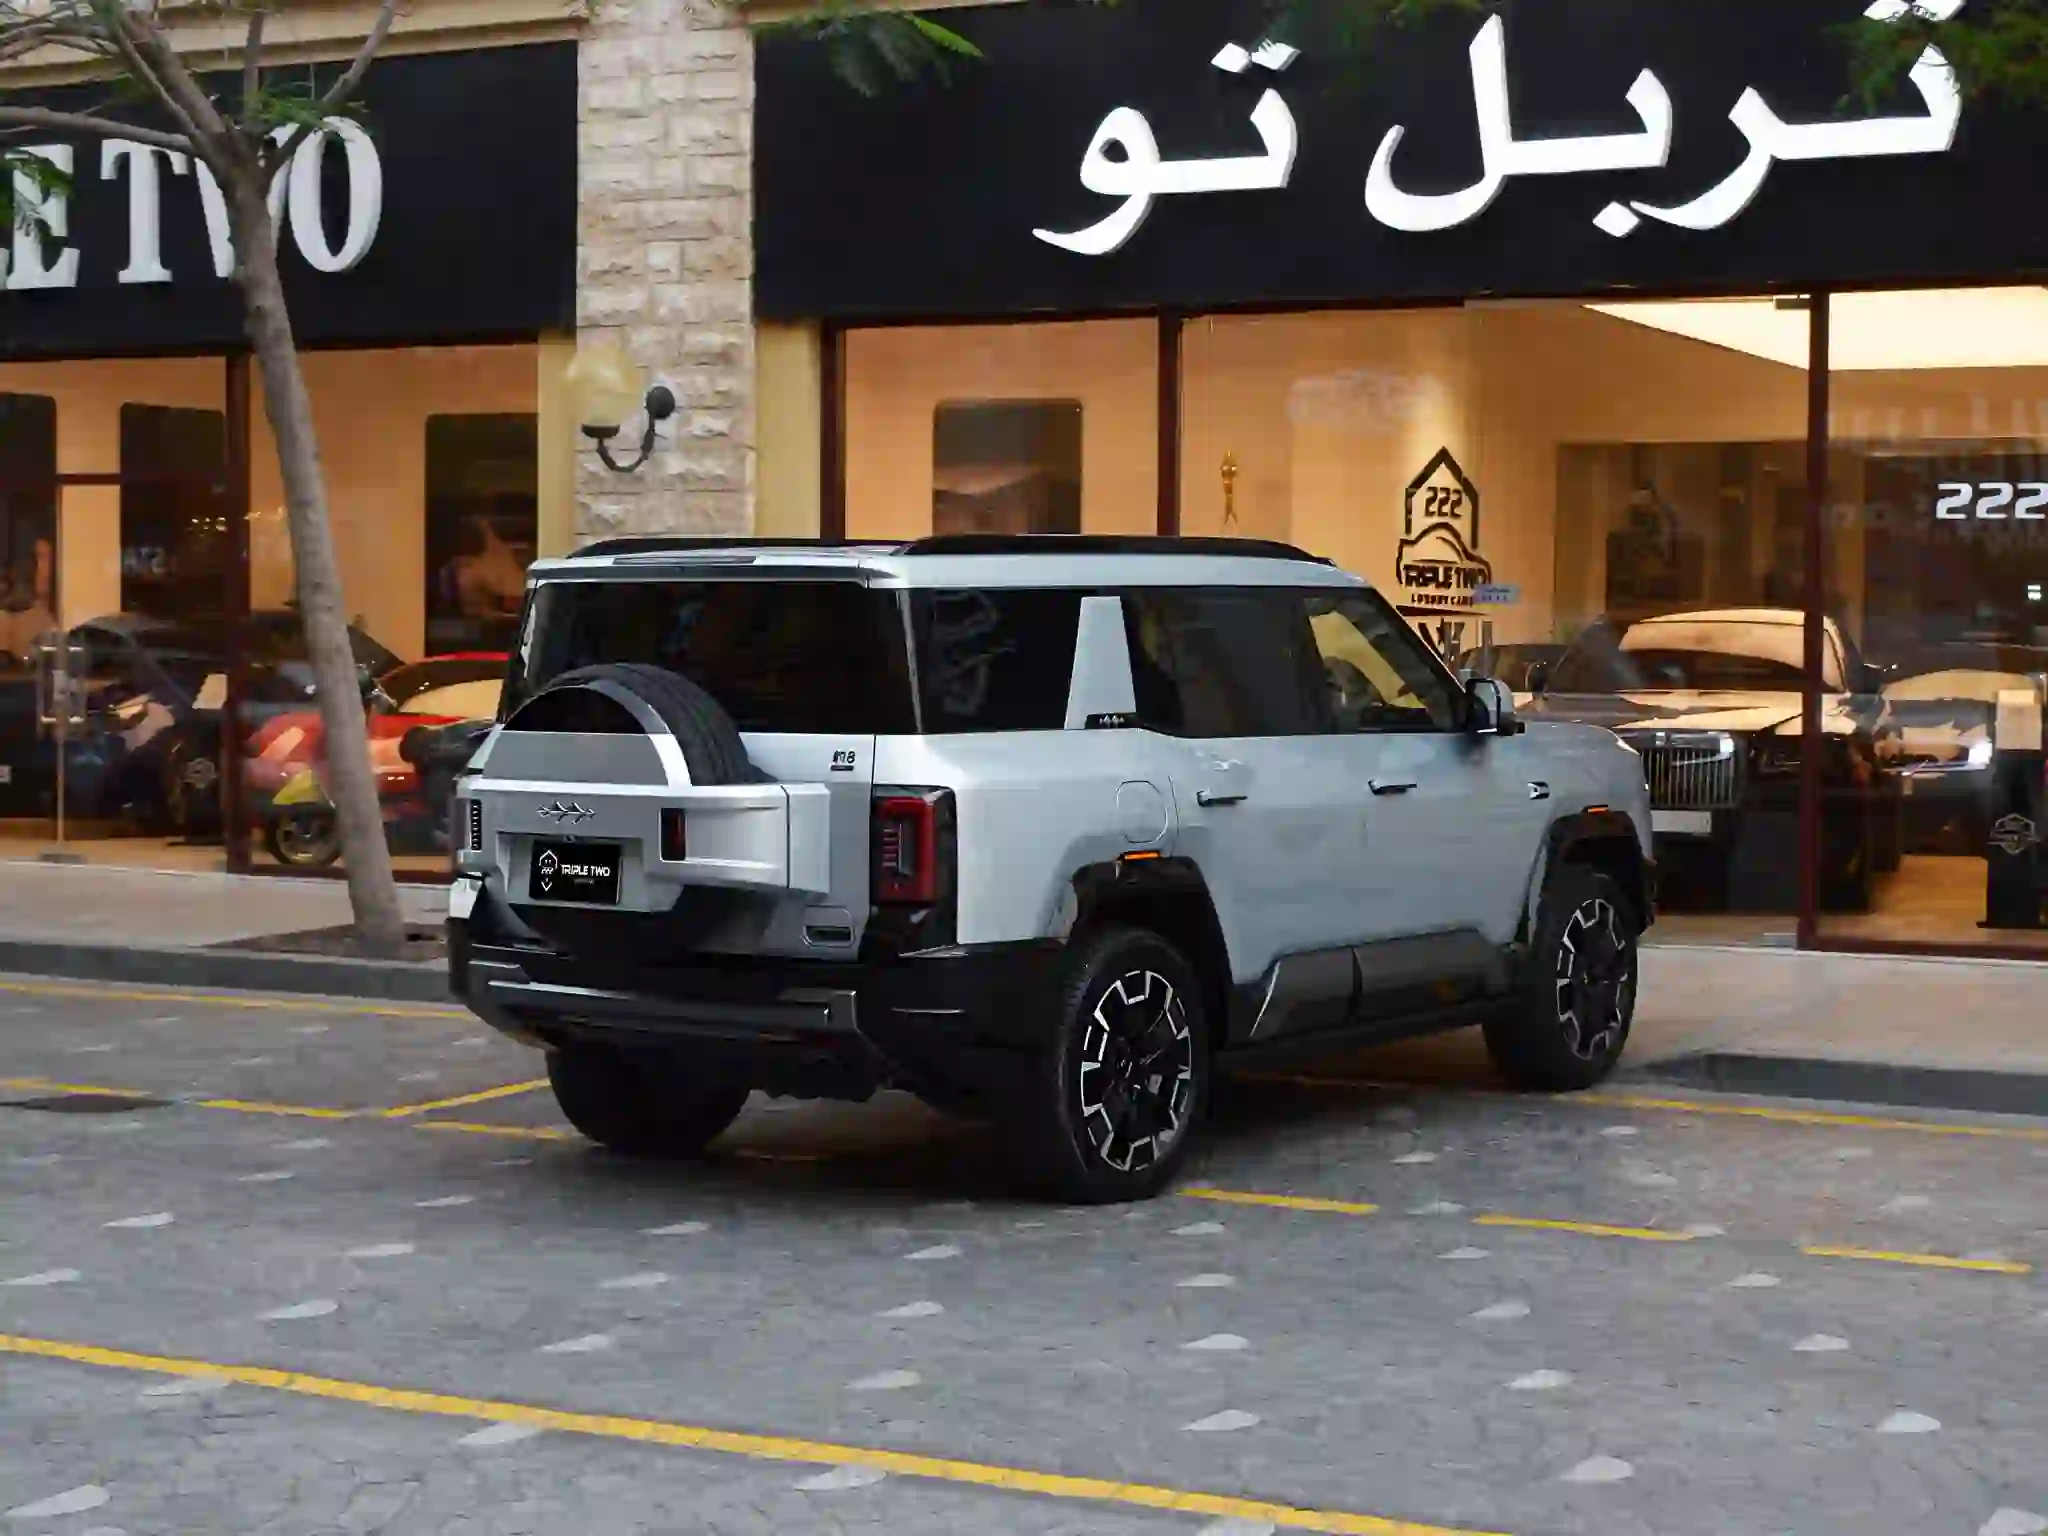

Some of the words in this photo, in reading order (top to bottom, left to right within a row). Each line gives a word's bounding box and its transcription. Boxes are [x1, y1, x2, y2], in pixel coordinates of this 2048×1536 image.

[1032, 40, 1301, 256] تو
[0, 143, 80, 290] E
[1425, 486, 1463, 518] 222
[1936, 482, 2048, 519] 222
[561, 864, 589, 876] TRIPLE
[590, 865, 611, 877] TWO
